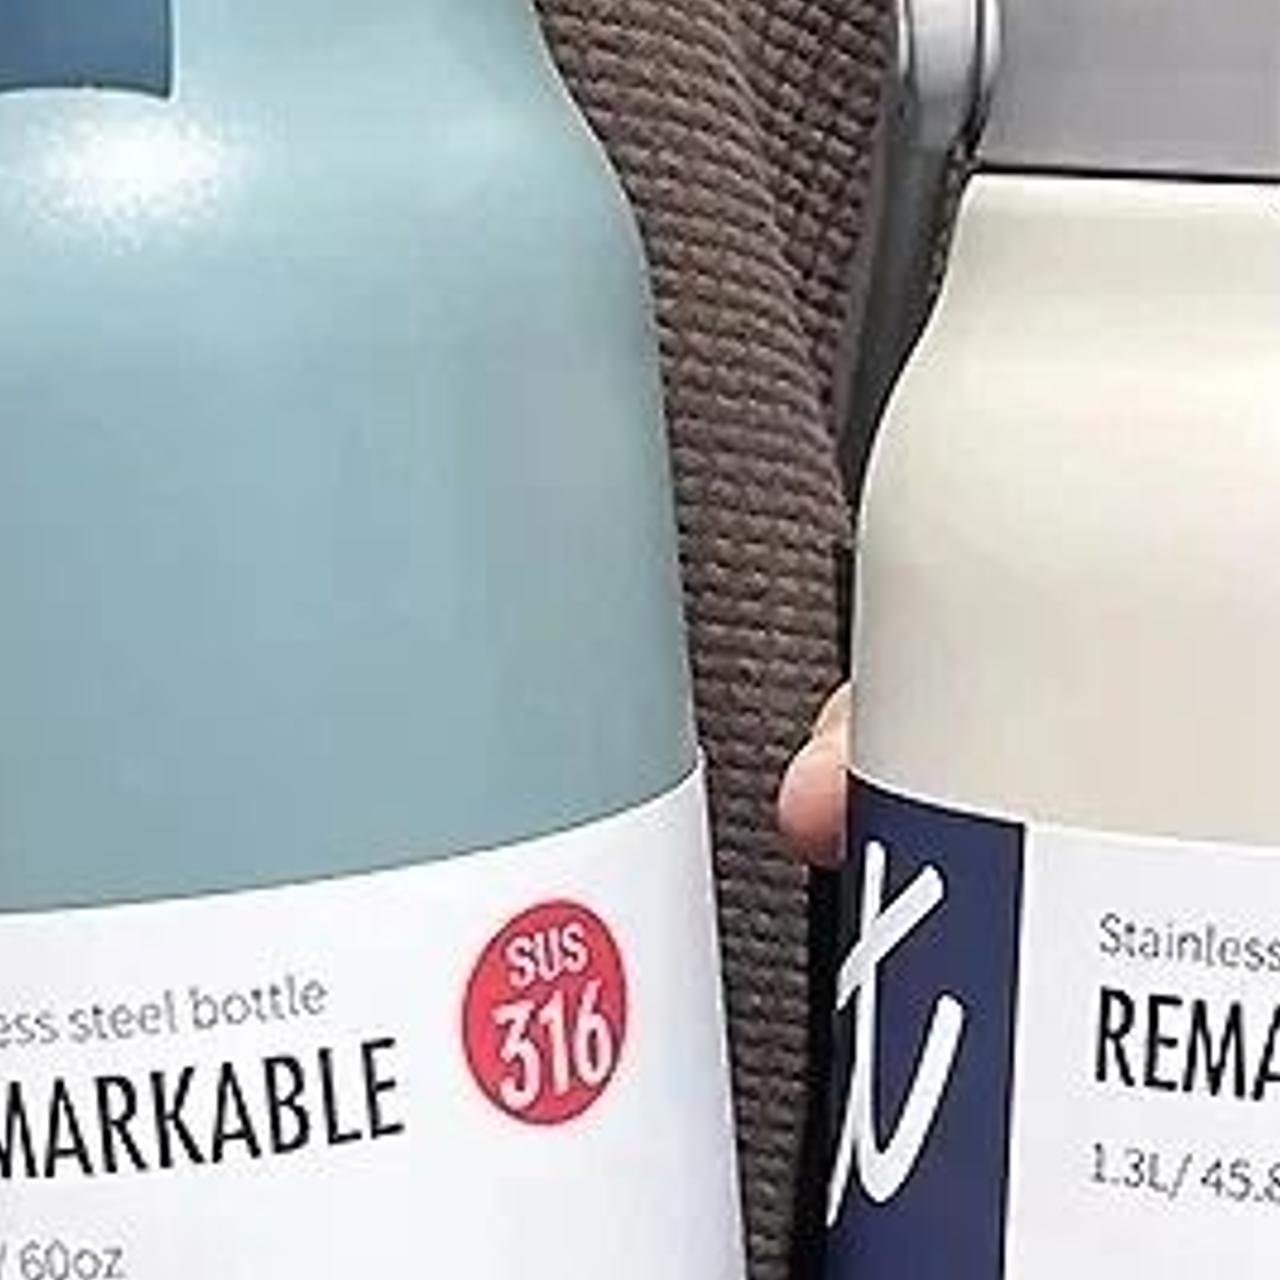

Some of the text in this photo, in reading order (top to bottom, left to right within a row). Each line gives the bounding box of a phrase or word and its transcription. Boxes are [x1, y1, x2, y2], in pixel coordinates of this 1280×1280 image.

[505, 922, 589, 989] SUS
[69, 988, 178, 1044] steel
[189, 973, 329, 1032] bottle
[491, 977, 614, 1109] 316
